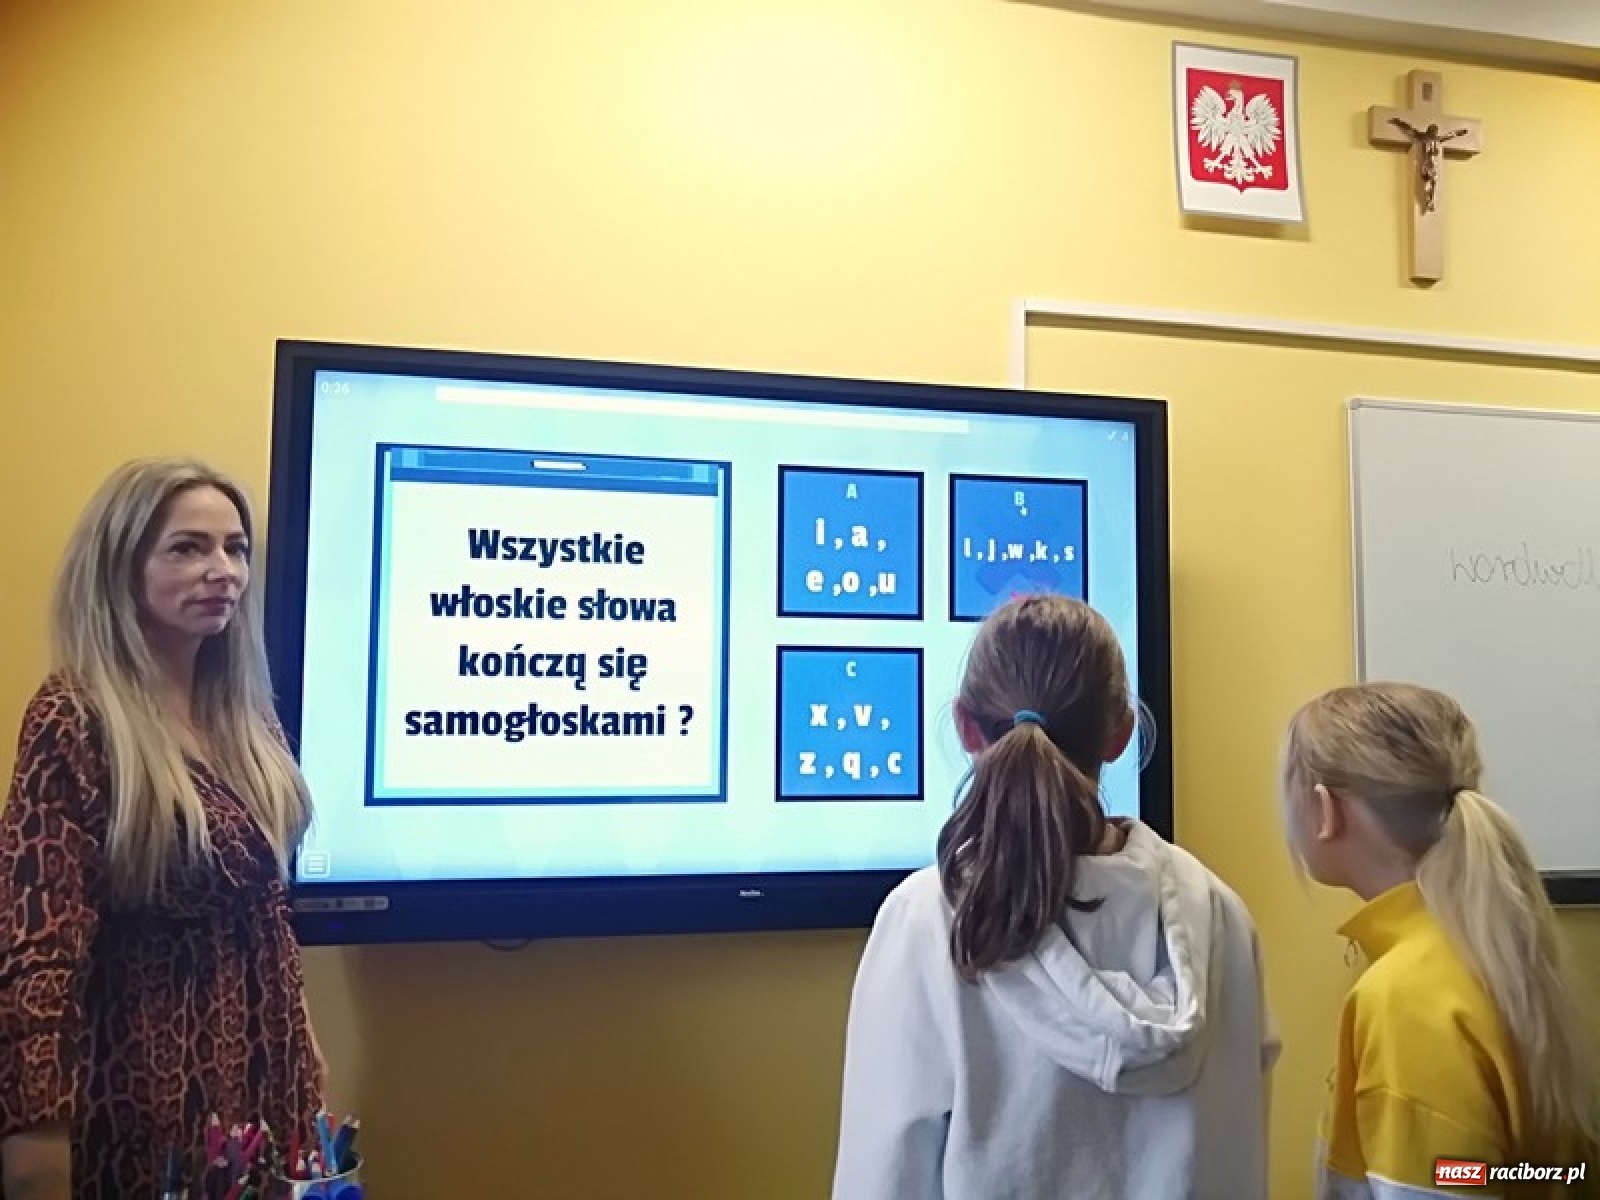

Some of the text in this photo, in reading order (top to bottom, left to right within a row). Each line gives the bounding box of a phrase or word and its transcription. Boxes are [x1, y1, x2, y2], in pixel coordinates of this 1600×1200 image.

[846, 483, 858, 499] A
[1014, 490, 1025, 507] B
[467, 527, 646, 569] Wszystkie
[429, 583, 678, 623] włoskie słowa
[459, 642, 649, 691] kończą się
[845, 661, 857, 678] C
[405, 702, 695, 743] samogłoskami ?
